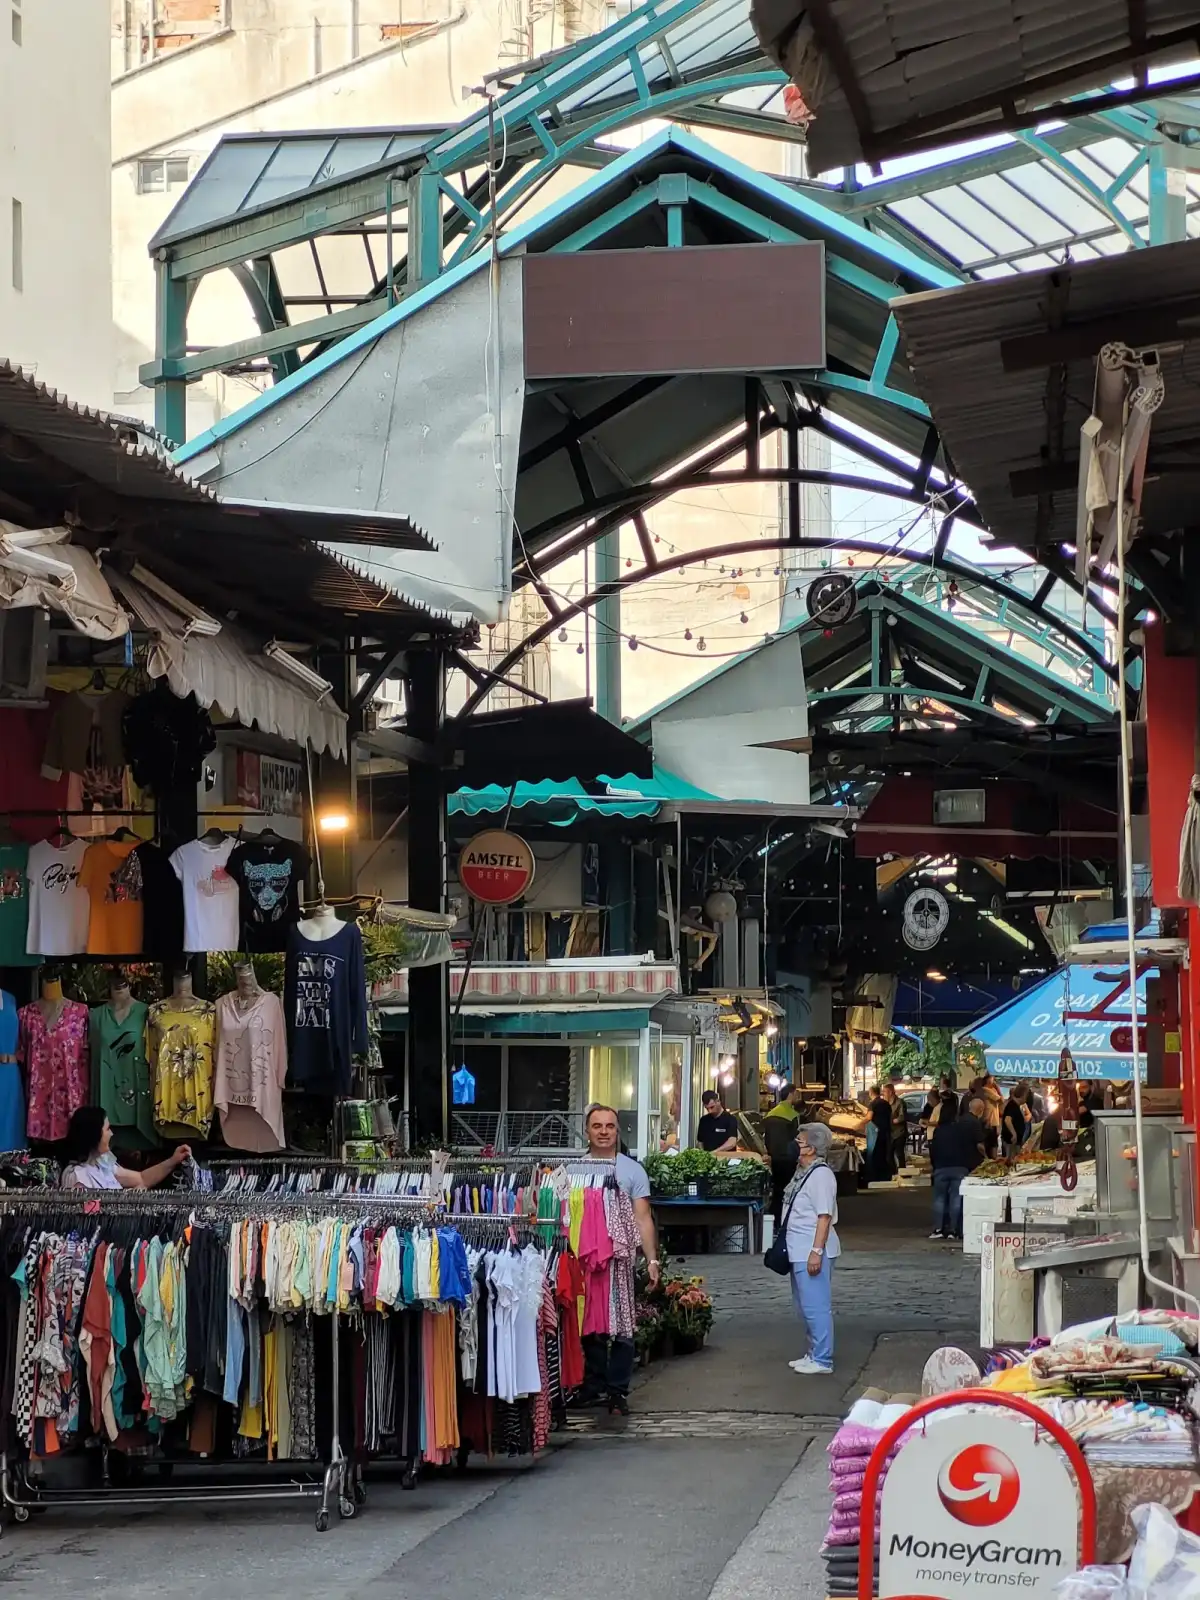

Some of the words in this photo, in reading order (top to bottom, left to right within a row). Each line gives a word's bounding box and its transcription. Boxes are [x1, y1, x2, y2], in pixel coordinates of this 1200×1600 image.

[466, 852, 523, 868] AMSTEL
[478, 870, 509, 880] BEER
[1032, 1032, 1106, 1048] ΠΑΝΤΑ
[889, 1533, 1062, 1567] MoneyGram
[915, 1568, 972, 1587] money
[974, 1569, 1040, 1588] transfer
